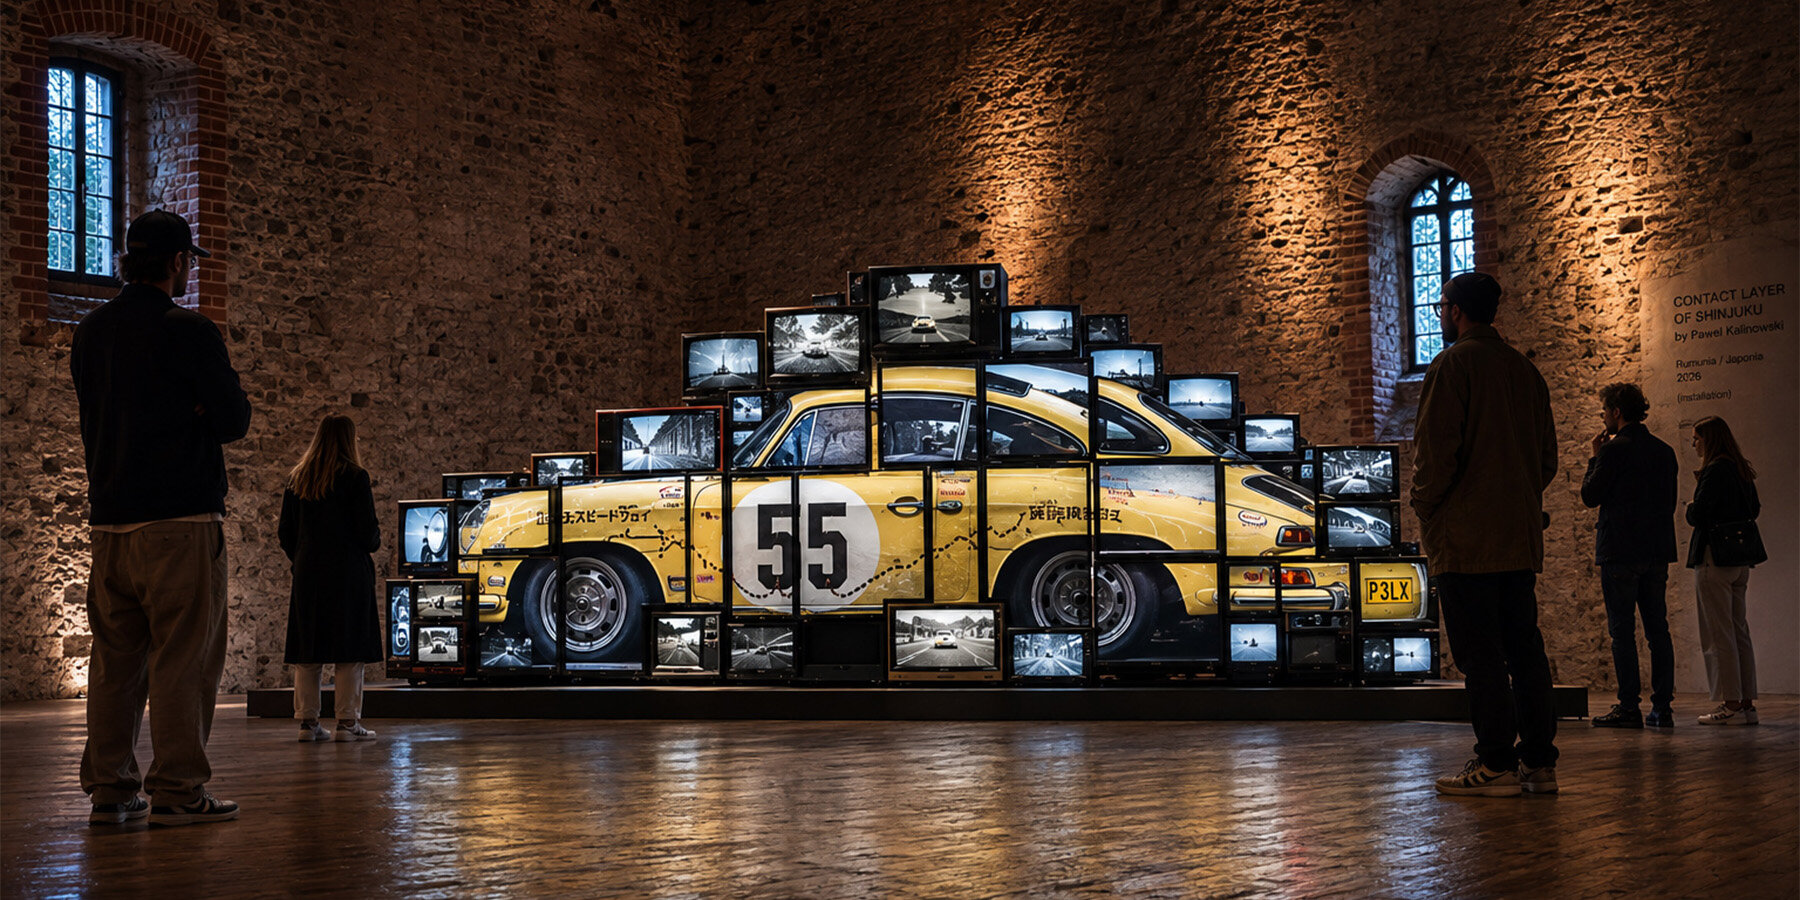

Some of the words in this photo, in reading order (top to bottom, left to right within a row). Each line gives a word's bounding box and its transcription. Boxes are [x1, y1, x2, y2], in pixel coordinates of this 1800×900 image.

[1673, 289, 1737, 307] CONTACT
[1741, 283, 1786, 300] LAYER
[1674, 311, 1691, 324] OF
[1695, 303, 1763, 323] SHINJUKU
[1674, 331, 1688, 343] by
[1726, 319, 1784, 336] Kalinowski
[1676, 356, 1717, 369] Rumunia
[1718, 355, 1724, 366] /
[1676, 371, 1702, 383] 2026
[757, 502, 848, 590] 55
[1369, 581, 1410, 601] P3LX
